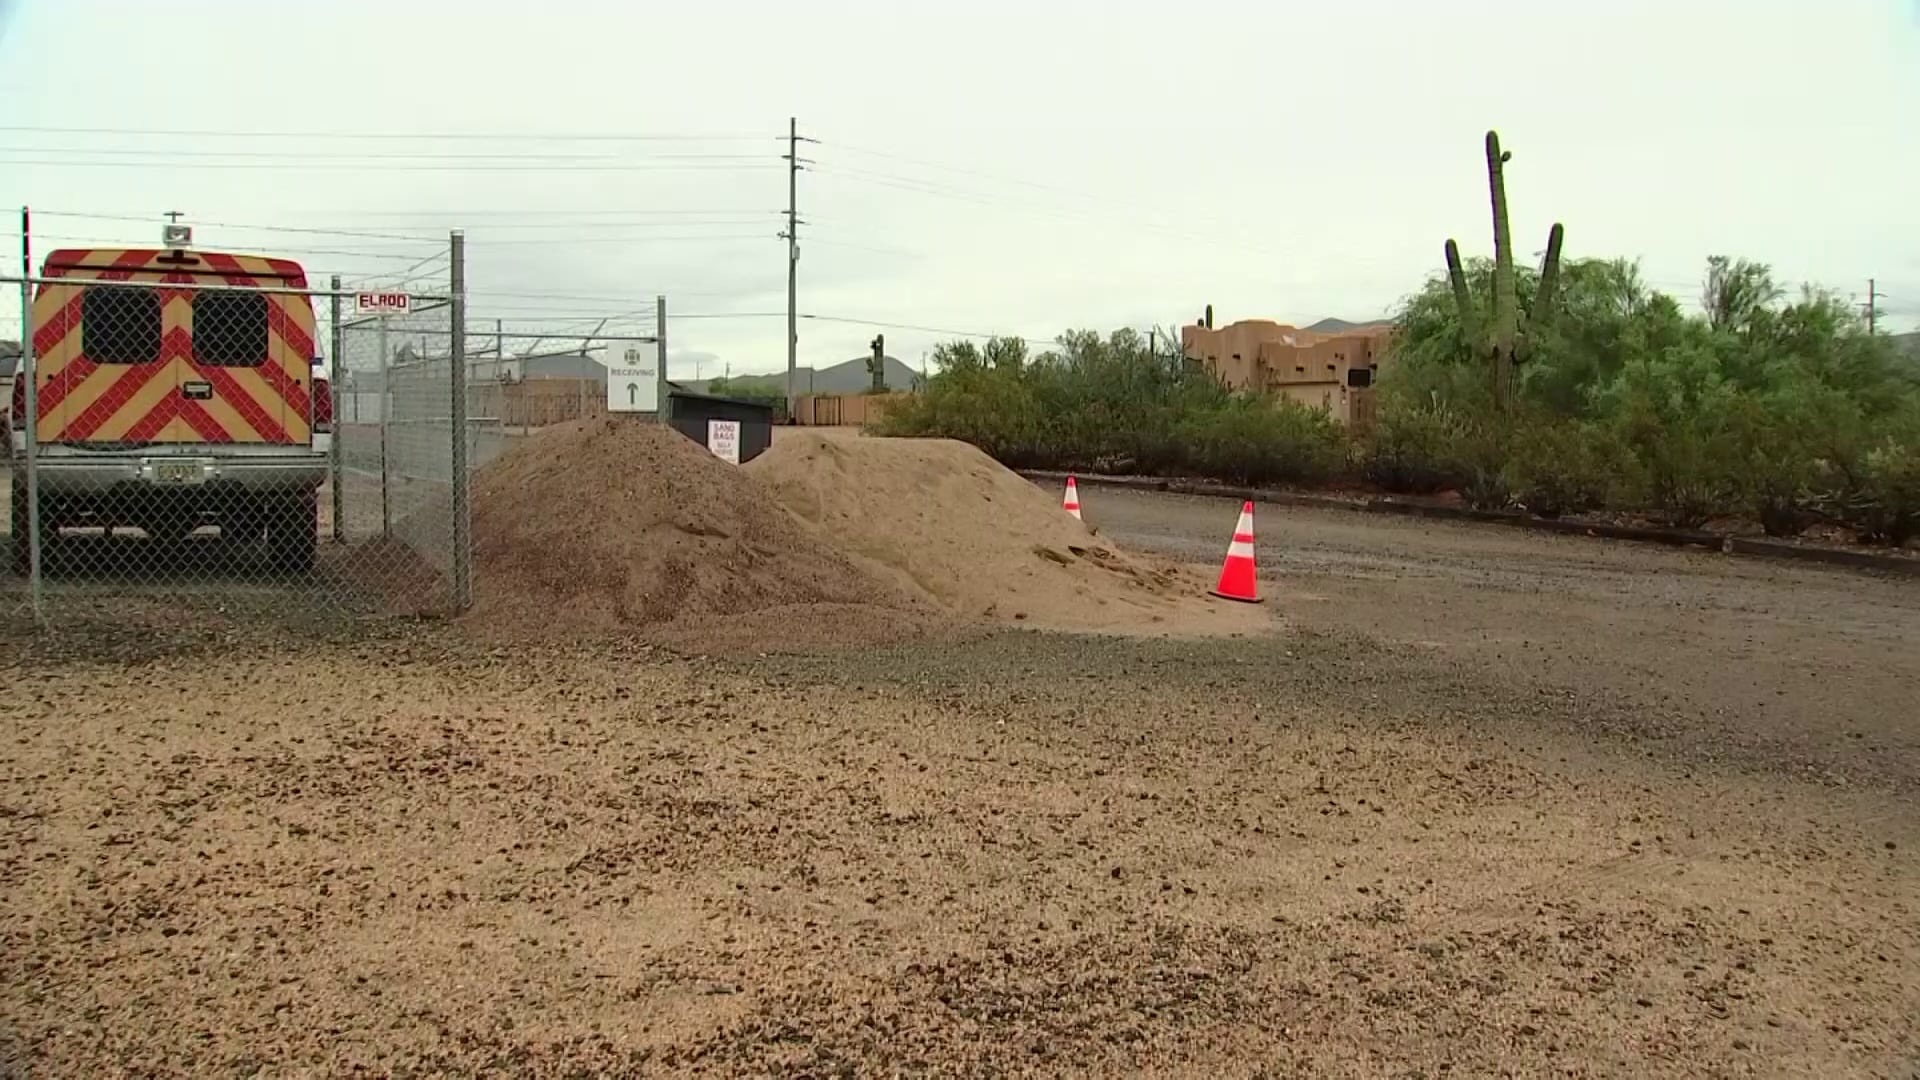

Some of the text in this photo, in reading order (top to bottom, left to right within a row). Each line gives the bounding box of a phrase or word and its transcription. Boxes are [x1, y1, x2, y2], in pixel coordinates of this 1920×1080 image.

[360, 295, 406, 308] ELROD
[611, 368, 655, 377] RECEIVING
[713, 423, 735, 432] SAND
[713, 432, 735, 440] BAGS
